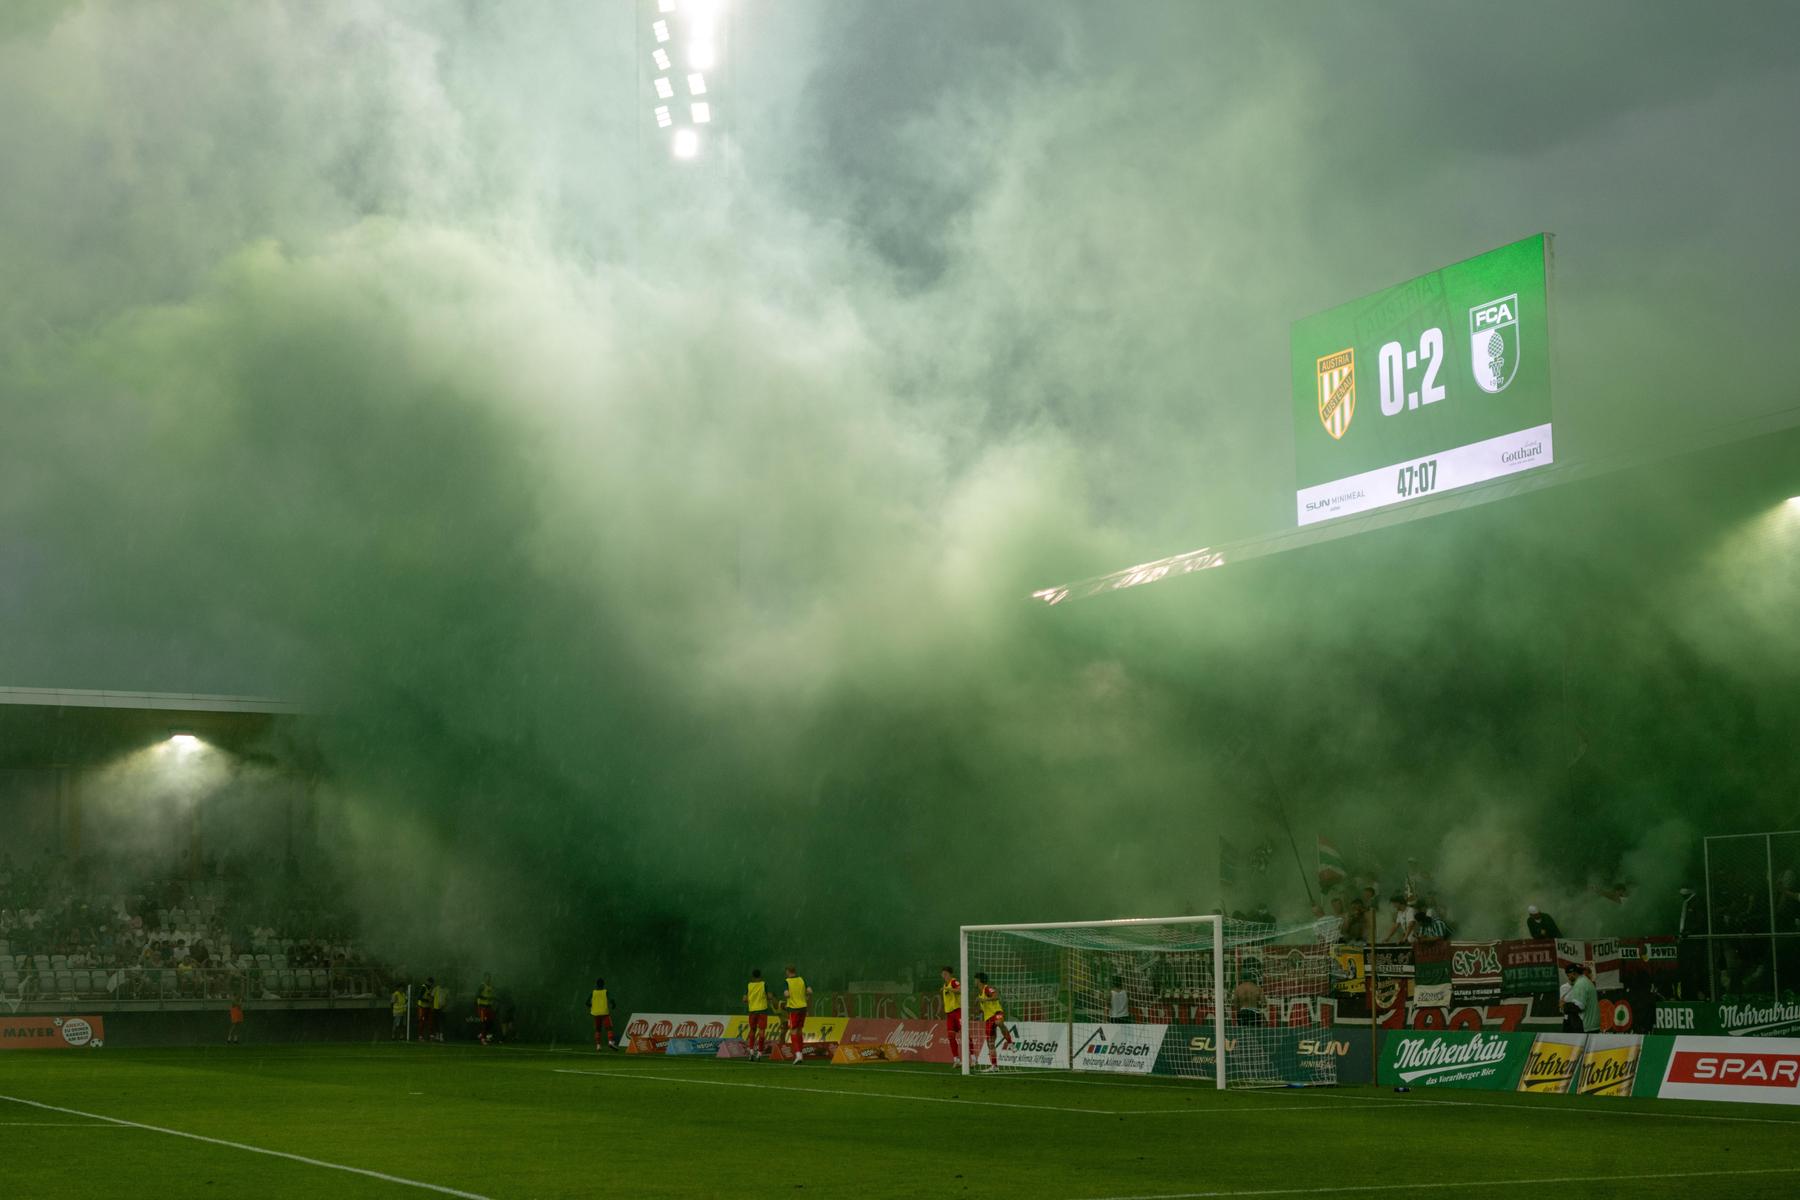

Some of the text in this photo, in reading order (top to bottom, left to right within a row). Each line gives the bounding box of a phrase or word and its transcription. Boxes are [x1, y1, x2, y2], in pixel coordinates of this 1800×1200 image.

[1476, 303, 1513, 327] FCA
[1321, 352, 1351, 372] AUSTRIA
[1379, 327, 1446, 417] 0:2
[1502, 442, 1542, 463] Gotthard
[1397, 460, 1437, 498] 47:07
[1306, 490, 1366, 511] SUN MINIMEAL
[4, 1027, 53, 1037] MAYER
[1021, 1040, 1059, 1053] bösch
[1108, 1042, 1150, 1056] bösch
[1296, 1040, 1350, 1056] SUN
[1393, 1033, 1508, 1069] Mohrenbräu
[1426, 1077, 1437, 1085] das
[1481, 1068, 1496, 1077] Bier
[1693, 1058, 1798, 1082] SPAR
